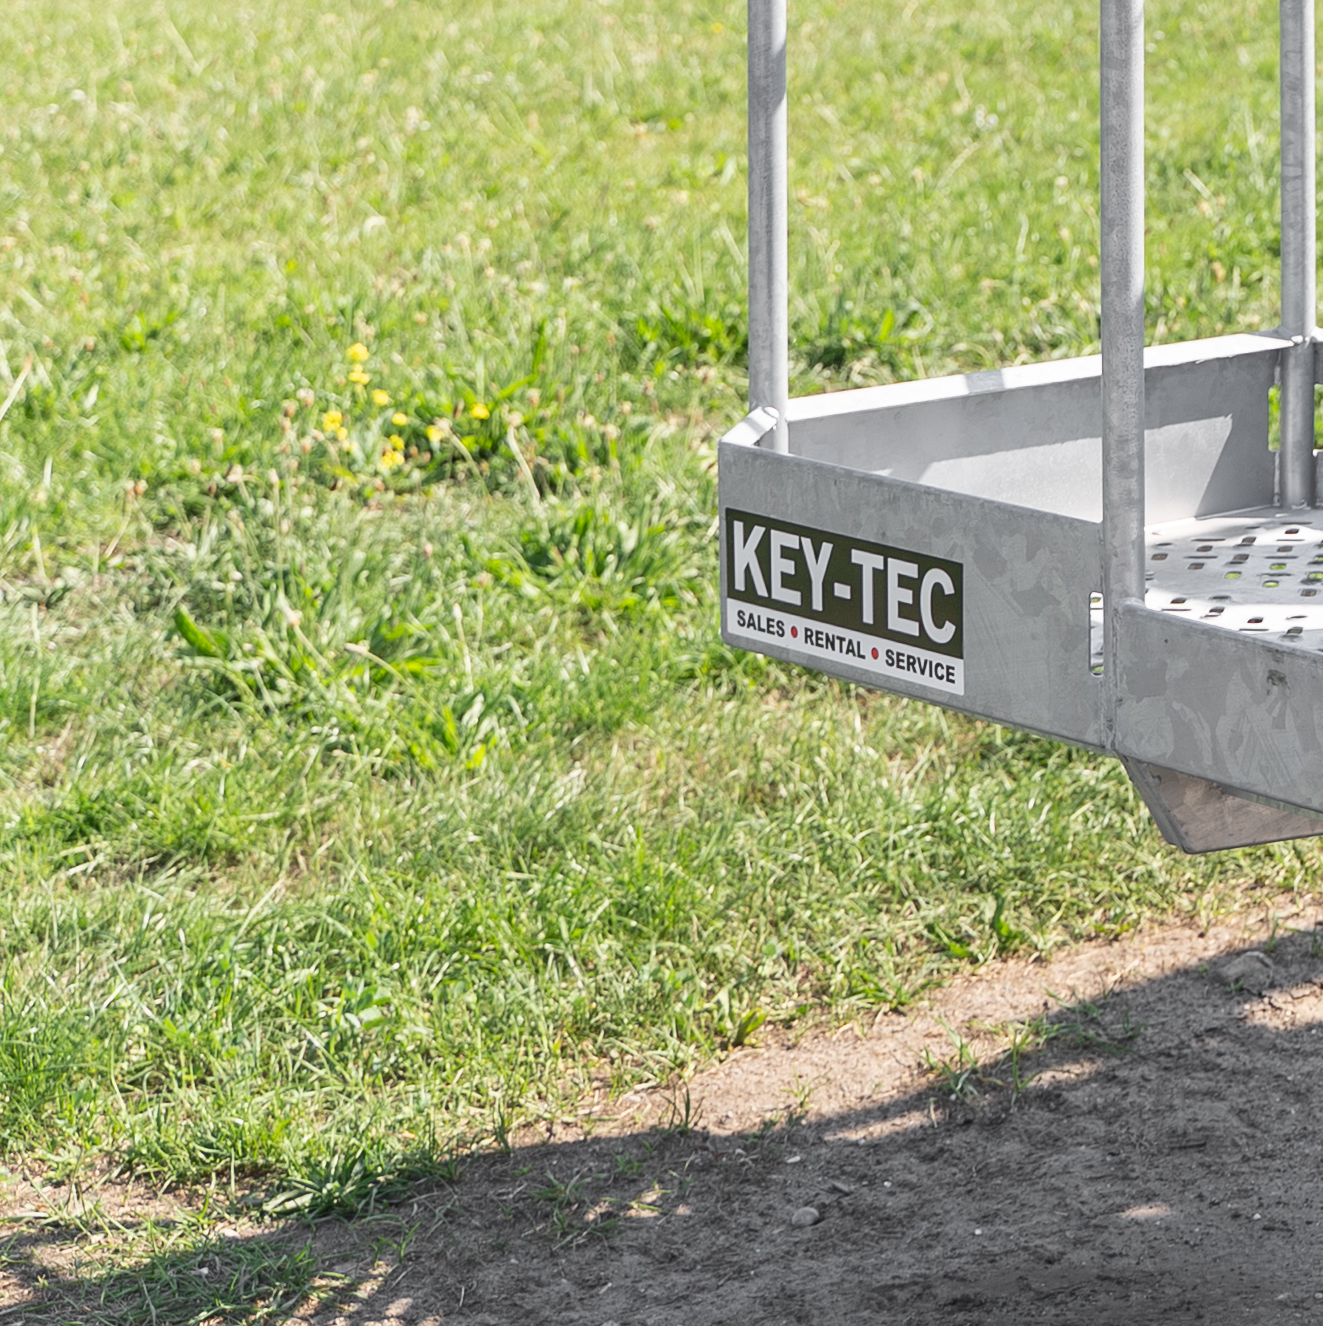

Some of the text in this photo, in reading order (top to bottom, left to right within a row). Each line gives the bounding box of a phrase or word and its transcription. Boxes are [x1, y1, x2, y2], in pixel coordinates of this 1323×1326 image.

[733, 520, 957, 644] KEY-TEC
[737, 610, 956, 684] SALES RENTAL SERVICE
